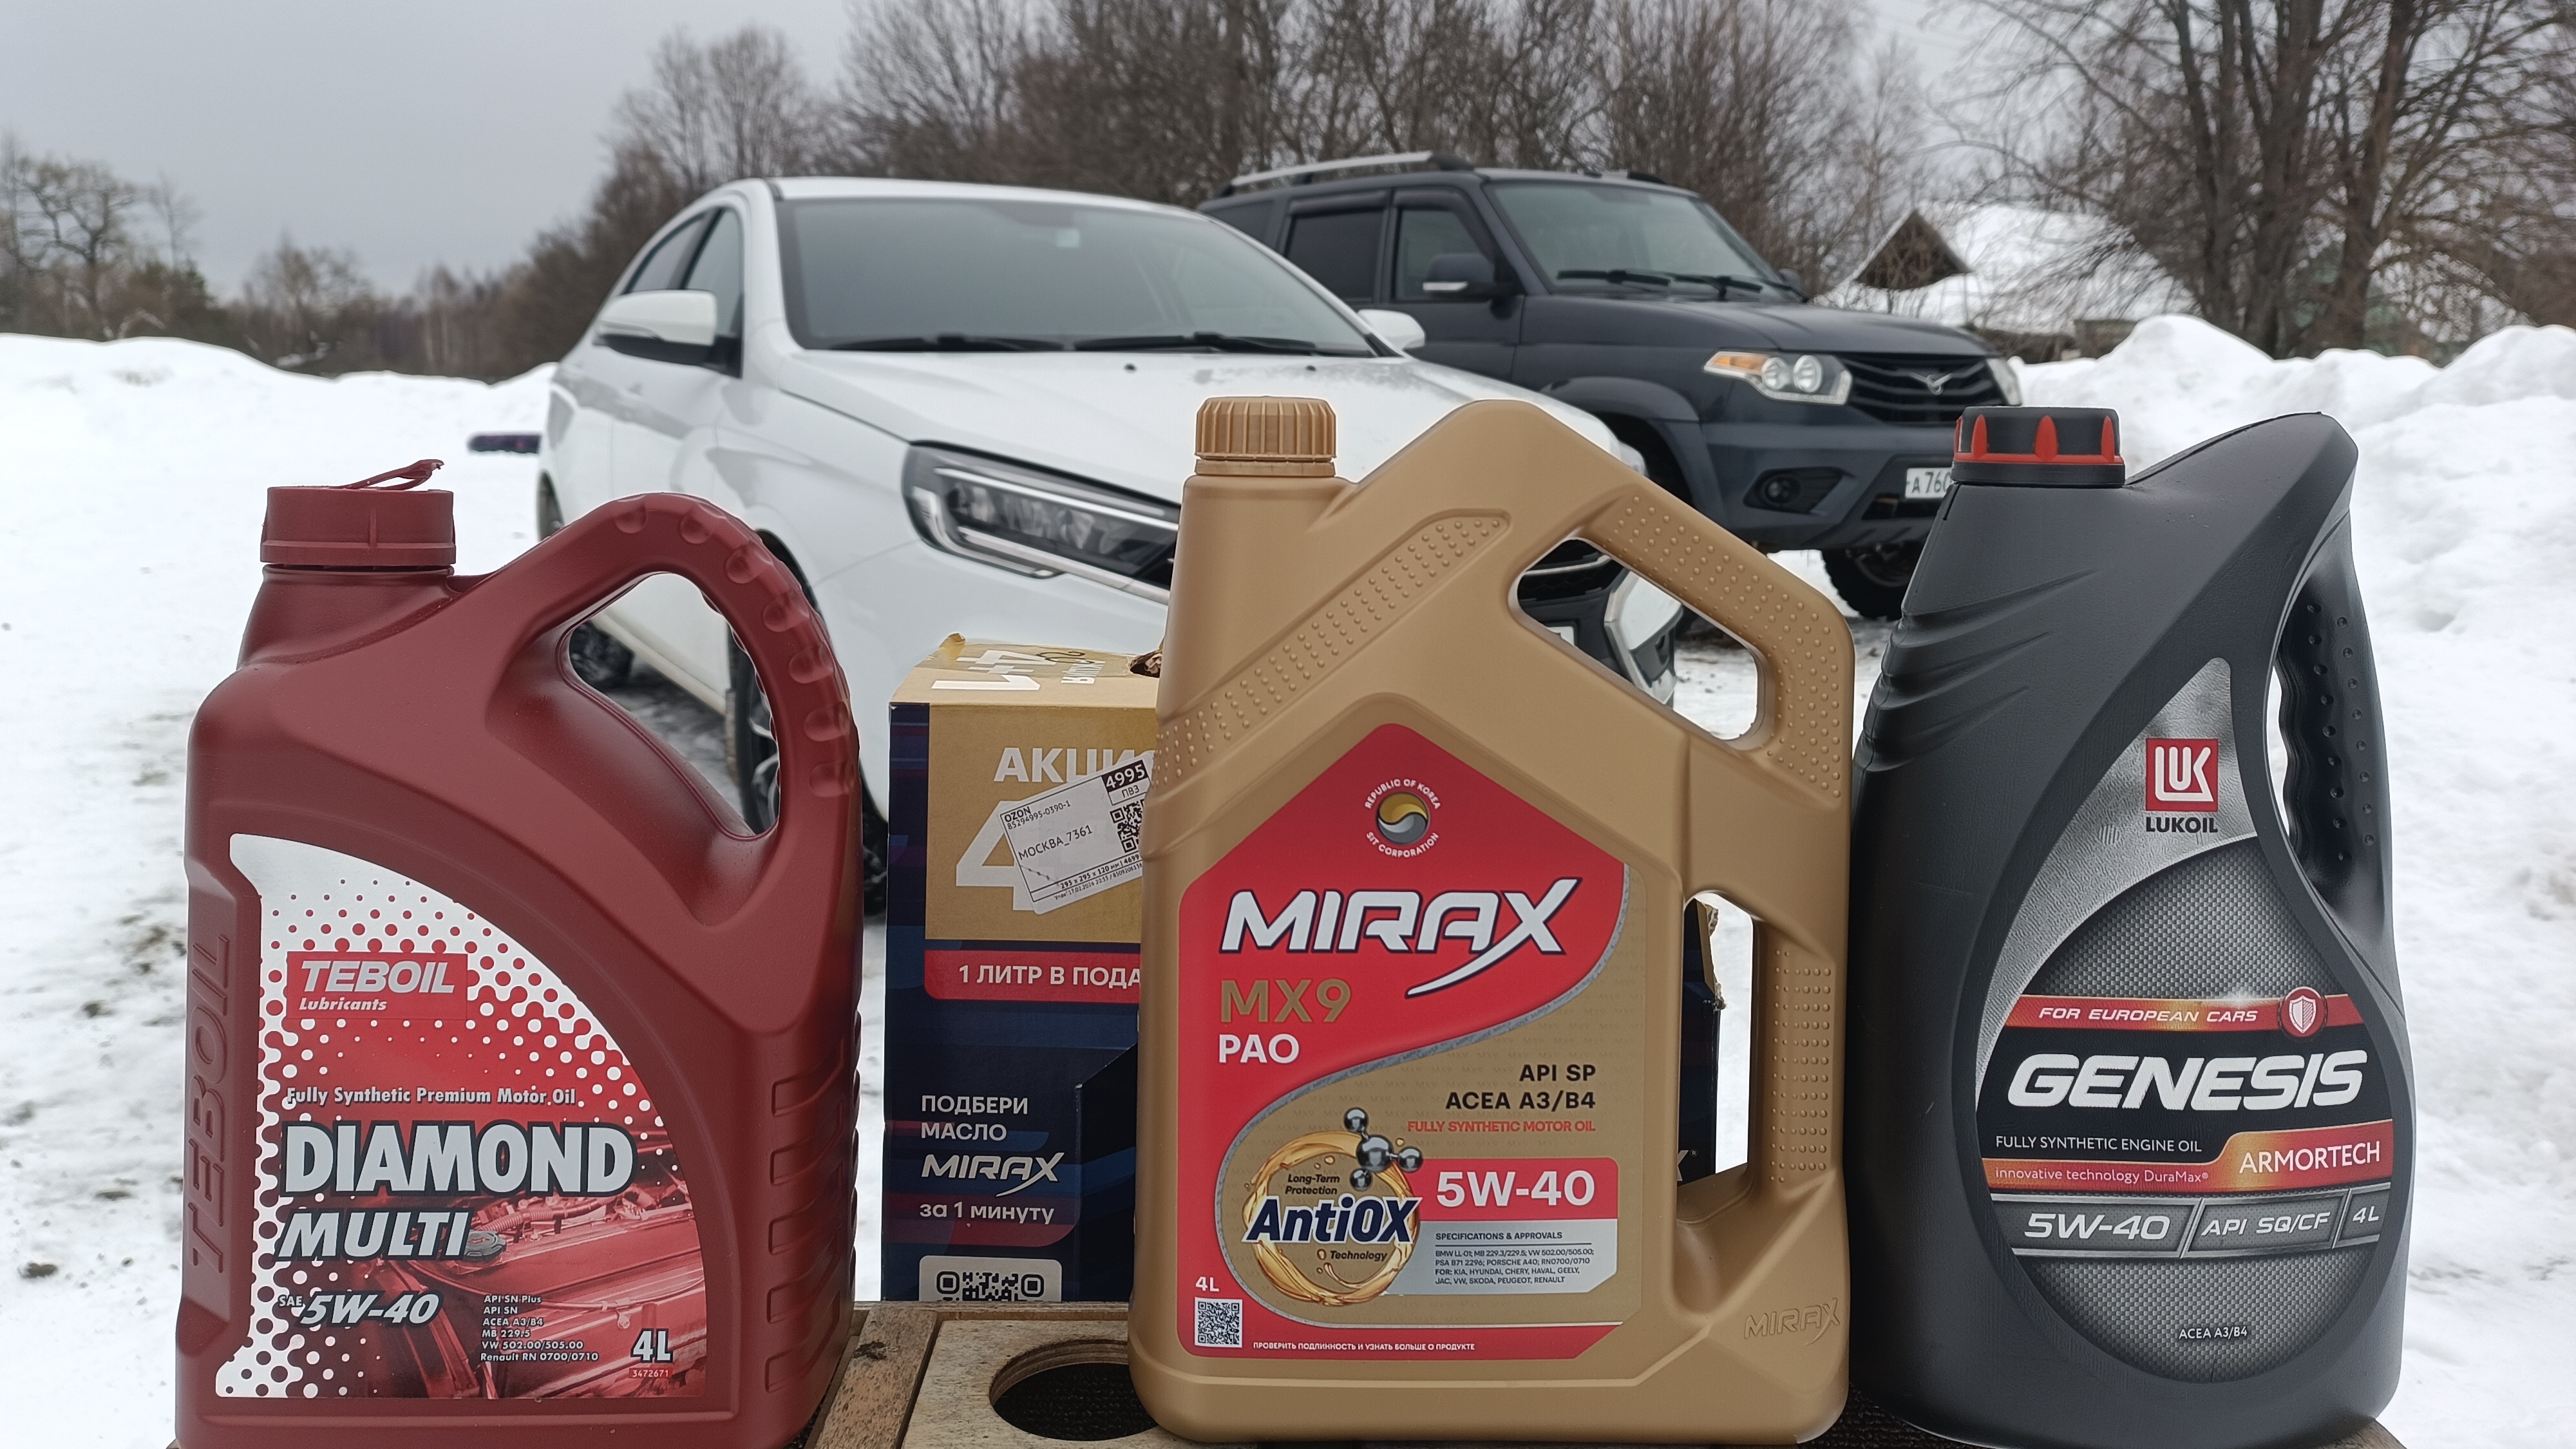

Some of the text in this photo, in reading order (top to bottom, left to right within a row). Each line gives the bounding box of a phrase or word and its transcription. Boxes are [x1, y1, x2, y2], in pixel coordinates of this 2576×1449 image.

[994, 747, 1155, 783] АКЦИ
[1106, 763, 1146, 789] 4995
[1121, 785, 1141, 798] ПВЗ
[1365, 779, 1441, 810] REPUBLIC OF KOREA
[1004, 806, 1032, 822] OZON
[1007, 800, 1071, 830] 85294995-0390-1
[2146, 816, 2219, 833] LUKOIL
[1018, 825, 1093, 860] МОСКВА_7361
[1366, 831, 1439, 858] SIT CORPORATION
[1060, 880, 1072, 889] 295
[1079, 873, 1091, 882] 295
[1097, 866, 1110, 875] 120
[1124, 854, 1140, 864] 4699
[1220, 878, 1581, 997] MIRAX
[301, 960, 455, 994] TEBOIL
[959, 965, 969, 983] 1
[976, 965, 1043, 984] ЛИТР
[1050, 967, 1065, 985] В
[299, 996, 388, 1010] Lubricants
[1220, 978, 1351, 1023] MX9
[2038, 1007, 2259, 1023] FOR EUROPEAN CARS
[1218, 1033, 1300, 1064] PAO
[1519, 1064, 1596, 1082] API SP
[2007, 1049, 2369, 1112] GENESIS
[187, 933, 230, 1274] TEBOIL
[287, 1086, 576, 1106] Fully Synthetic Premium Motor Oil
[922, 1095, 1028, 1115] ПОДБЕРИ
[1445, 1090, 1596, 1112] ACEA A3/B4
[921, 1122, 1007, 1141] МАСЛО
[1407, 1121, 1596, 1132] FULLY SYNTHETIC MOTOR OIL
[1996, 1135, 2202, 1153] FULLY SYNTHETIC ENGINE OIL
[283, 1123, 635, 1195] DIAMOND
[2239, 1141, 2380, 1174] ARMORTECH
[921, 1152, 1065, 1197] MIRAX
[1287, 1173, 1340, 1185] Long-Term
[1996, 1167, 2063, 1180] innovative
[2066, 1168, 2140, 1185] technology
[1285, 1185, 1338, 1195] Protection
[1436, 1170, 1595, 1208] 5W-40
[920, 1202, 1055, 1225] за 1 минуту
[1244, 1195, 1421, 1243] AntiOX
[2201, 1211, 2331, 1237] API SQ/CF
[2352, 1206, 2380, 1225] 4L
[276, 1211, 469, 1258] MULTI
[2023, 1213, 2171, 1240] 5W-40
[1330, 1250, 1388, 1262] Technology
[1195, 1276, 1220, 1292] 4L
[278, 1293, 440, 1325] SAE 5W-40
[522, 1295, 542, 1303] Plus
[483, 1306, 518, 1314] API SN
[482, 1318, 544, 1327] ACEA A3/B4
[1743, 1297, 1841, 1346] MIRAX
[2178, 1325, 2248, 1340] ACEA A3/B4
[482, 1341, 583, 1350] VW 502.00/505.00
[631, 1329, 672, 1362] 4L
[1298, 1342, 1356, 1351] ПОДЛИННОСТЬ
[480, 1352, 519, 1361] Renault
[540, 1352, 599, 1362] 0700/0710
[632, 1369, 669, 1378] 3472671
